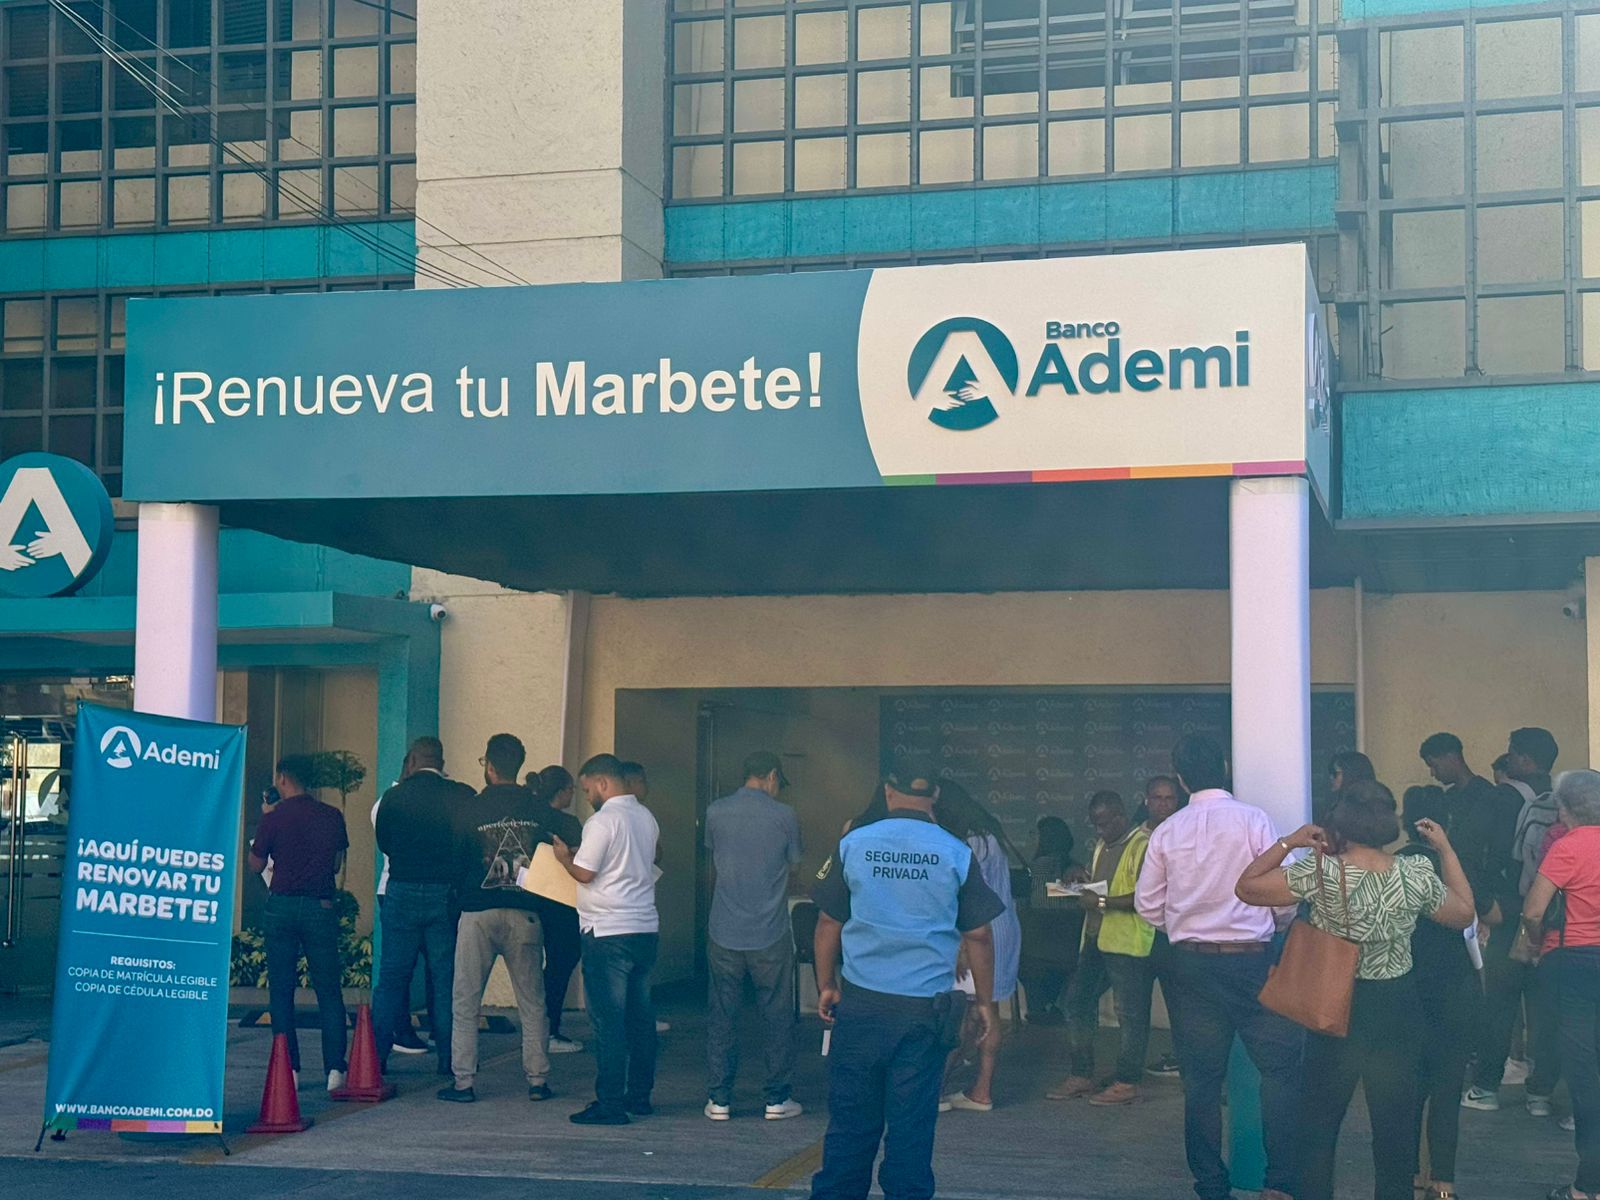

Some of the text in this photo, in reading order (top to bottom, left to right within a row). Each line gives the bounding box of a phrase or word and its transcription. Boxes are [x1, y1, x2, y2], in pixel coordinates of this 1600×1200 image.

[1045, 321, 1120, 340] Banco
[1025, 330, 1250, 397] Ademi
[153, 352, 822, 425] ¡Renueva tu Marbete!
[143, 741, 220, 770] Ademi
[78, 838, 225, 871] ¡AQUÍ PUEDES
[865, 850, 940, 866] SEGURIDAD
[77, 861, 221, 895] RENOVAR TU
[872, 866, 929, 881] PRIVADA
[75, 887, 219, 923] MARBETE!
[110, 956, 176, 970] REQUISITOS:
[67, 966, 218, 987] COPIA DE MATRÍCULA LEGIBLE
[75, 982, 209, 1000] COPIA DE CÉDULA LEGIBLE
[55, 1103, 214, 1118] WWW.BANCOADEMI.COM.DO
